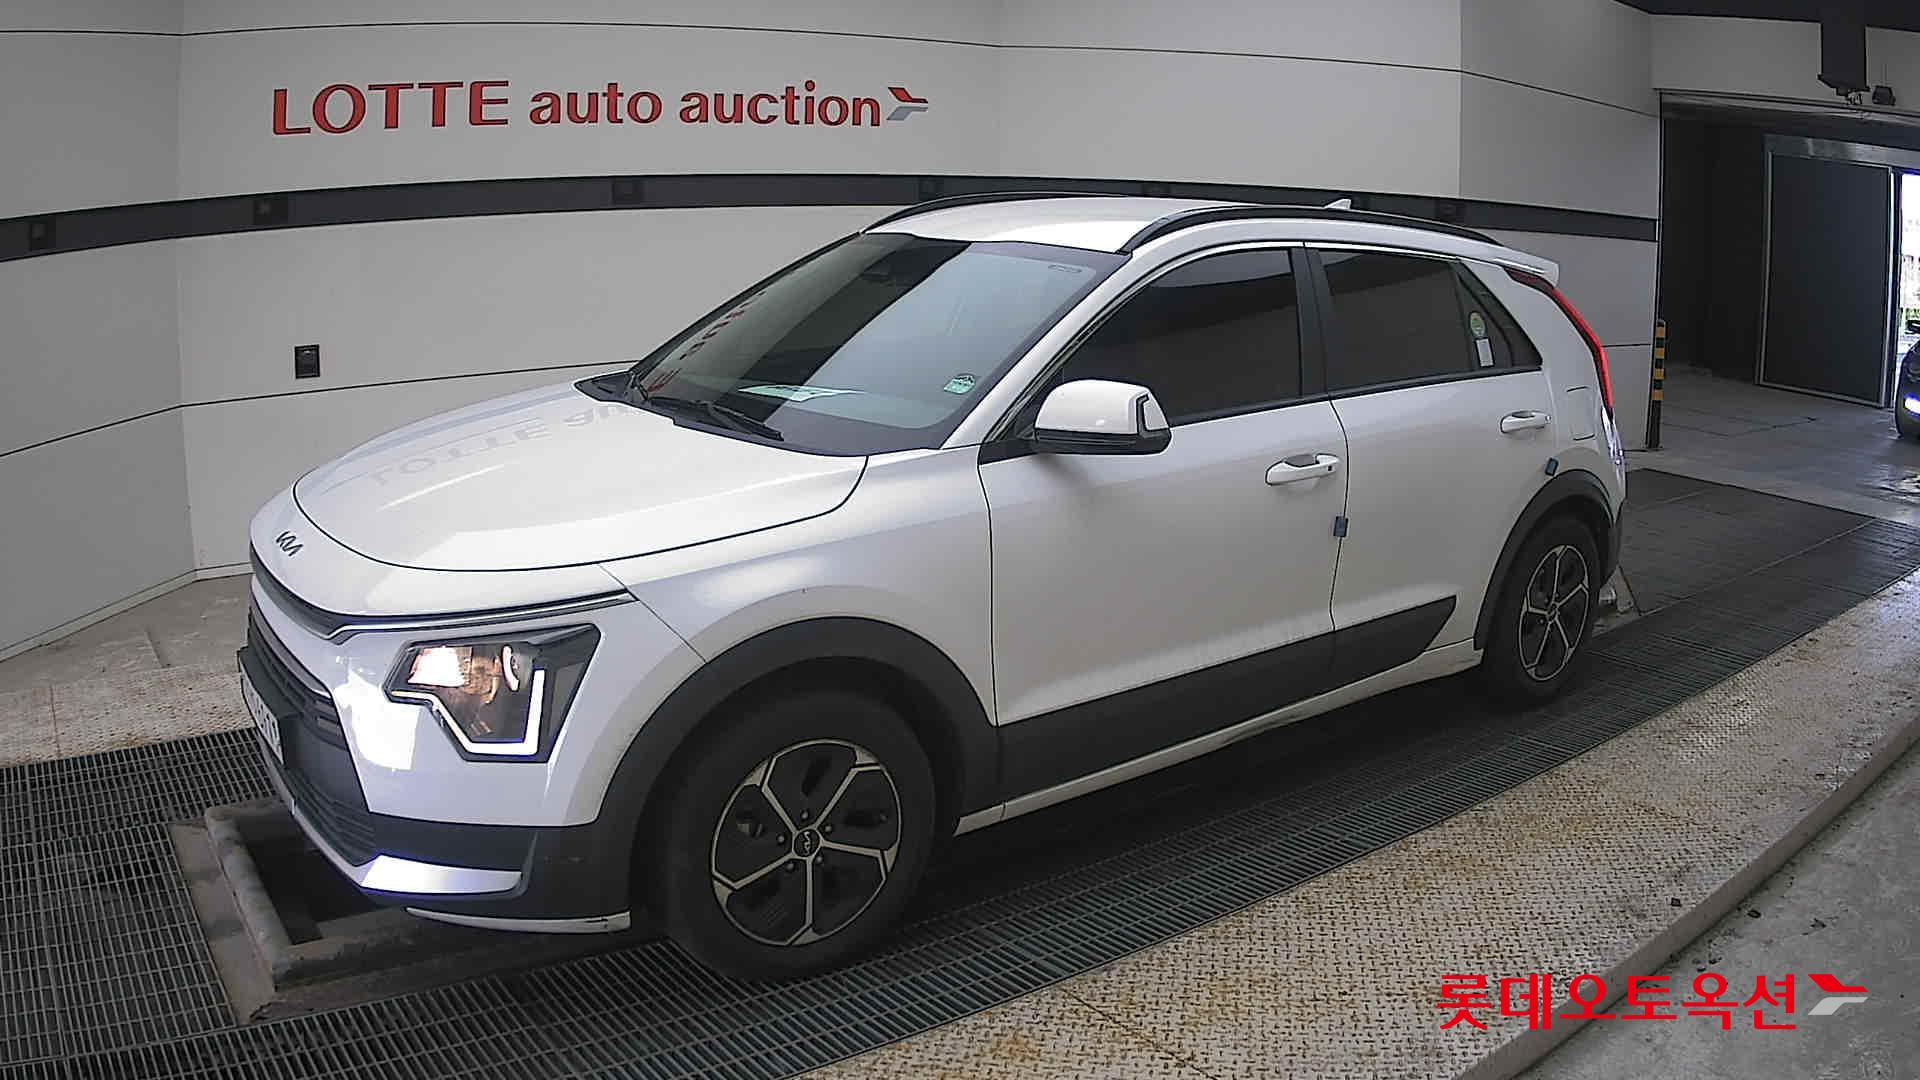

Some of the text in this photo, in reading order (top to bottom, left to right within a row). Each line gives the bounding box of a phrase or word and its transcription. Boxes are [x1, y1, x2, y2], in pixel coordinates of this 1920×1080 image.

[273, 80, 881, 135] LOTTE auto auction
